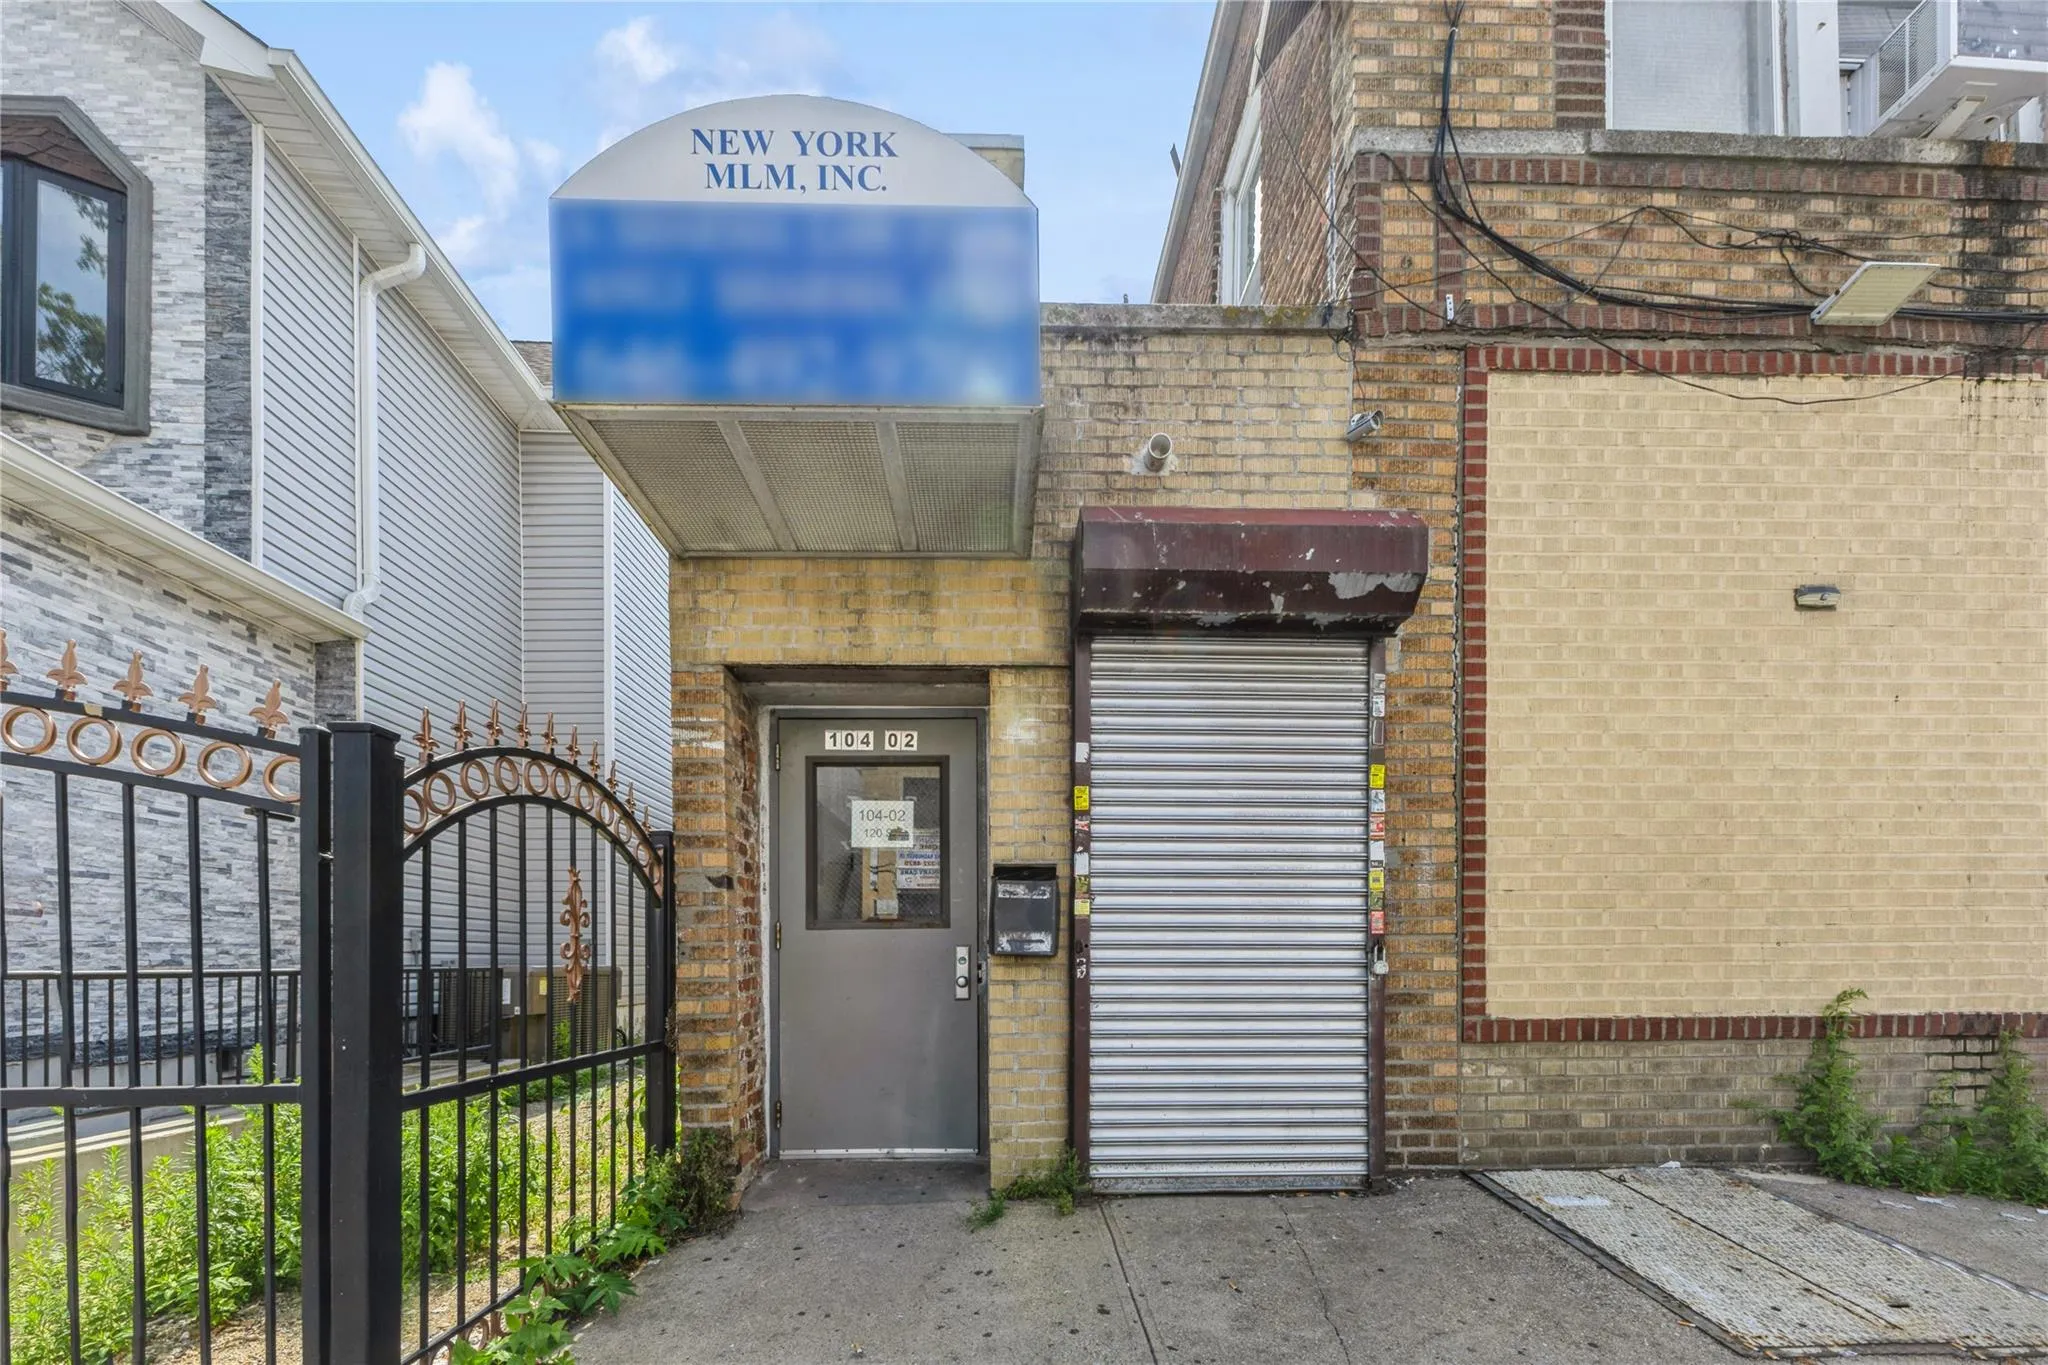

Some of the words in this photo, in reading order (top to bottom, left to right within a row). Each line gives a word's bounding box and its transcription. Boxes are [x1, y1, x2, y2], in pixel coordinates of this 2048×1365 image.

[690, 128, 775, 156] NEW
[791, 130, 899, 158] YORK
[704, 162, 807, 195] MLM,
[817, 164, 888, 193] INC.
[828, 732, 871, 748] 104
[887, 732, 915, 748] 02
[858, 809, 906, 822] 104-02
[864, 828, 883, 838] 120
